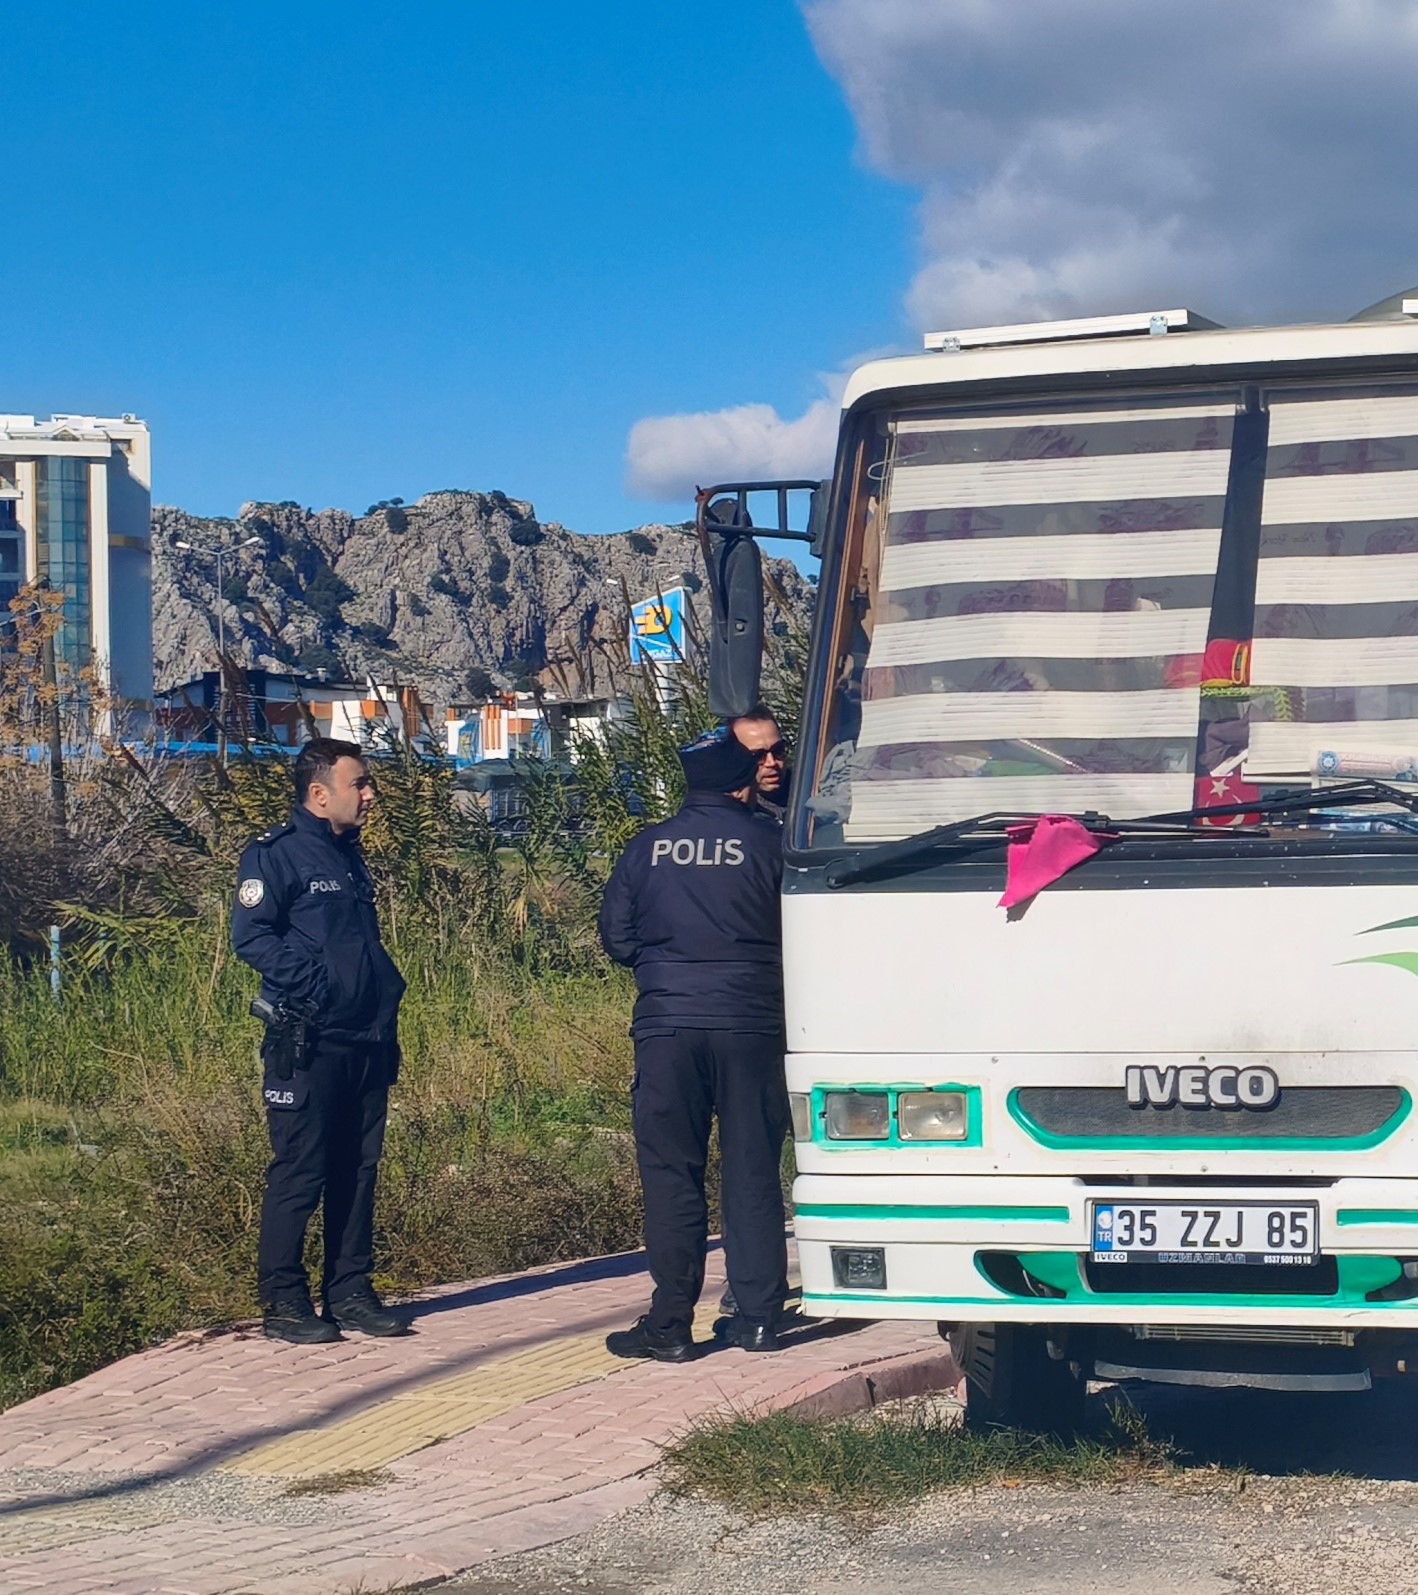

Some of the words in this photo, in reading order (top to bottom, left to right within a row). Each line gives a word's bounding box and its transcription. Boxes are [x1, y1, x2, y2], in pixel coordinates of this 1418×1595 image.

[1126, 1066, 1277, 1107] IVECO
[1098, 1231, 1112, 1242] TR
[1117, 1210, 1157, 1247] 35
[1180, 1210, 1243, 1248] ZZJ
[1267, 1211, 1308, 1248] 85
